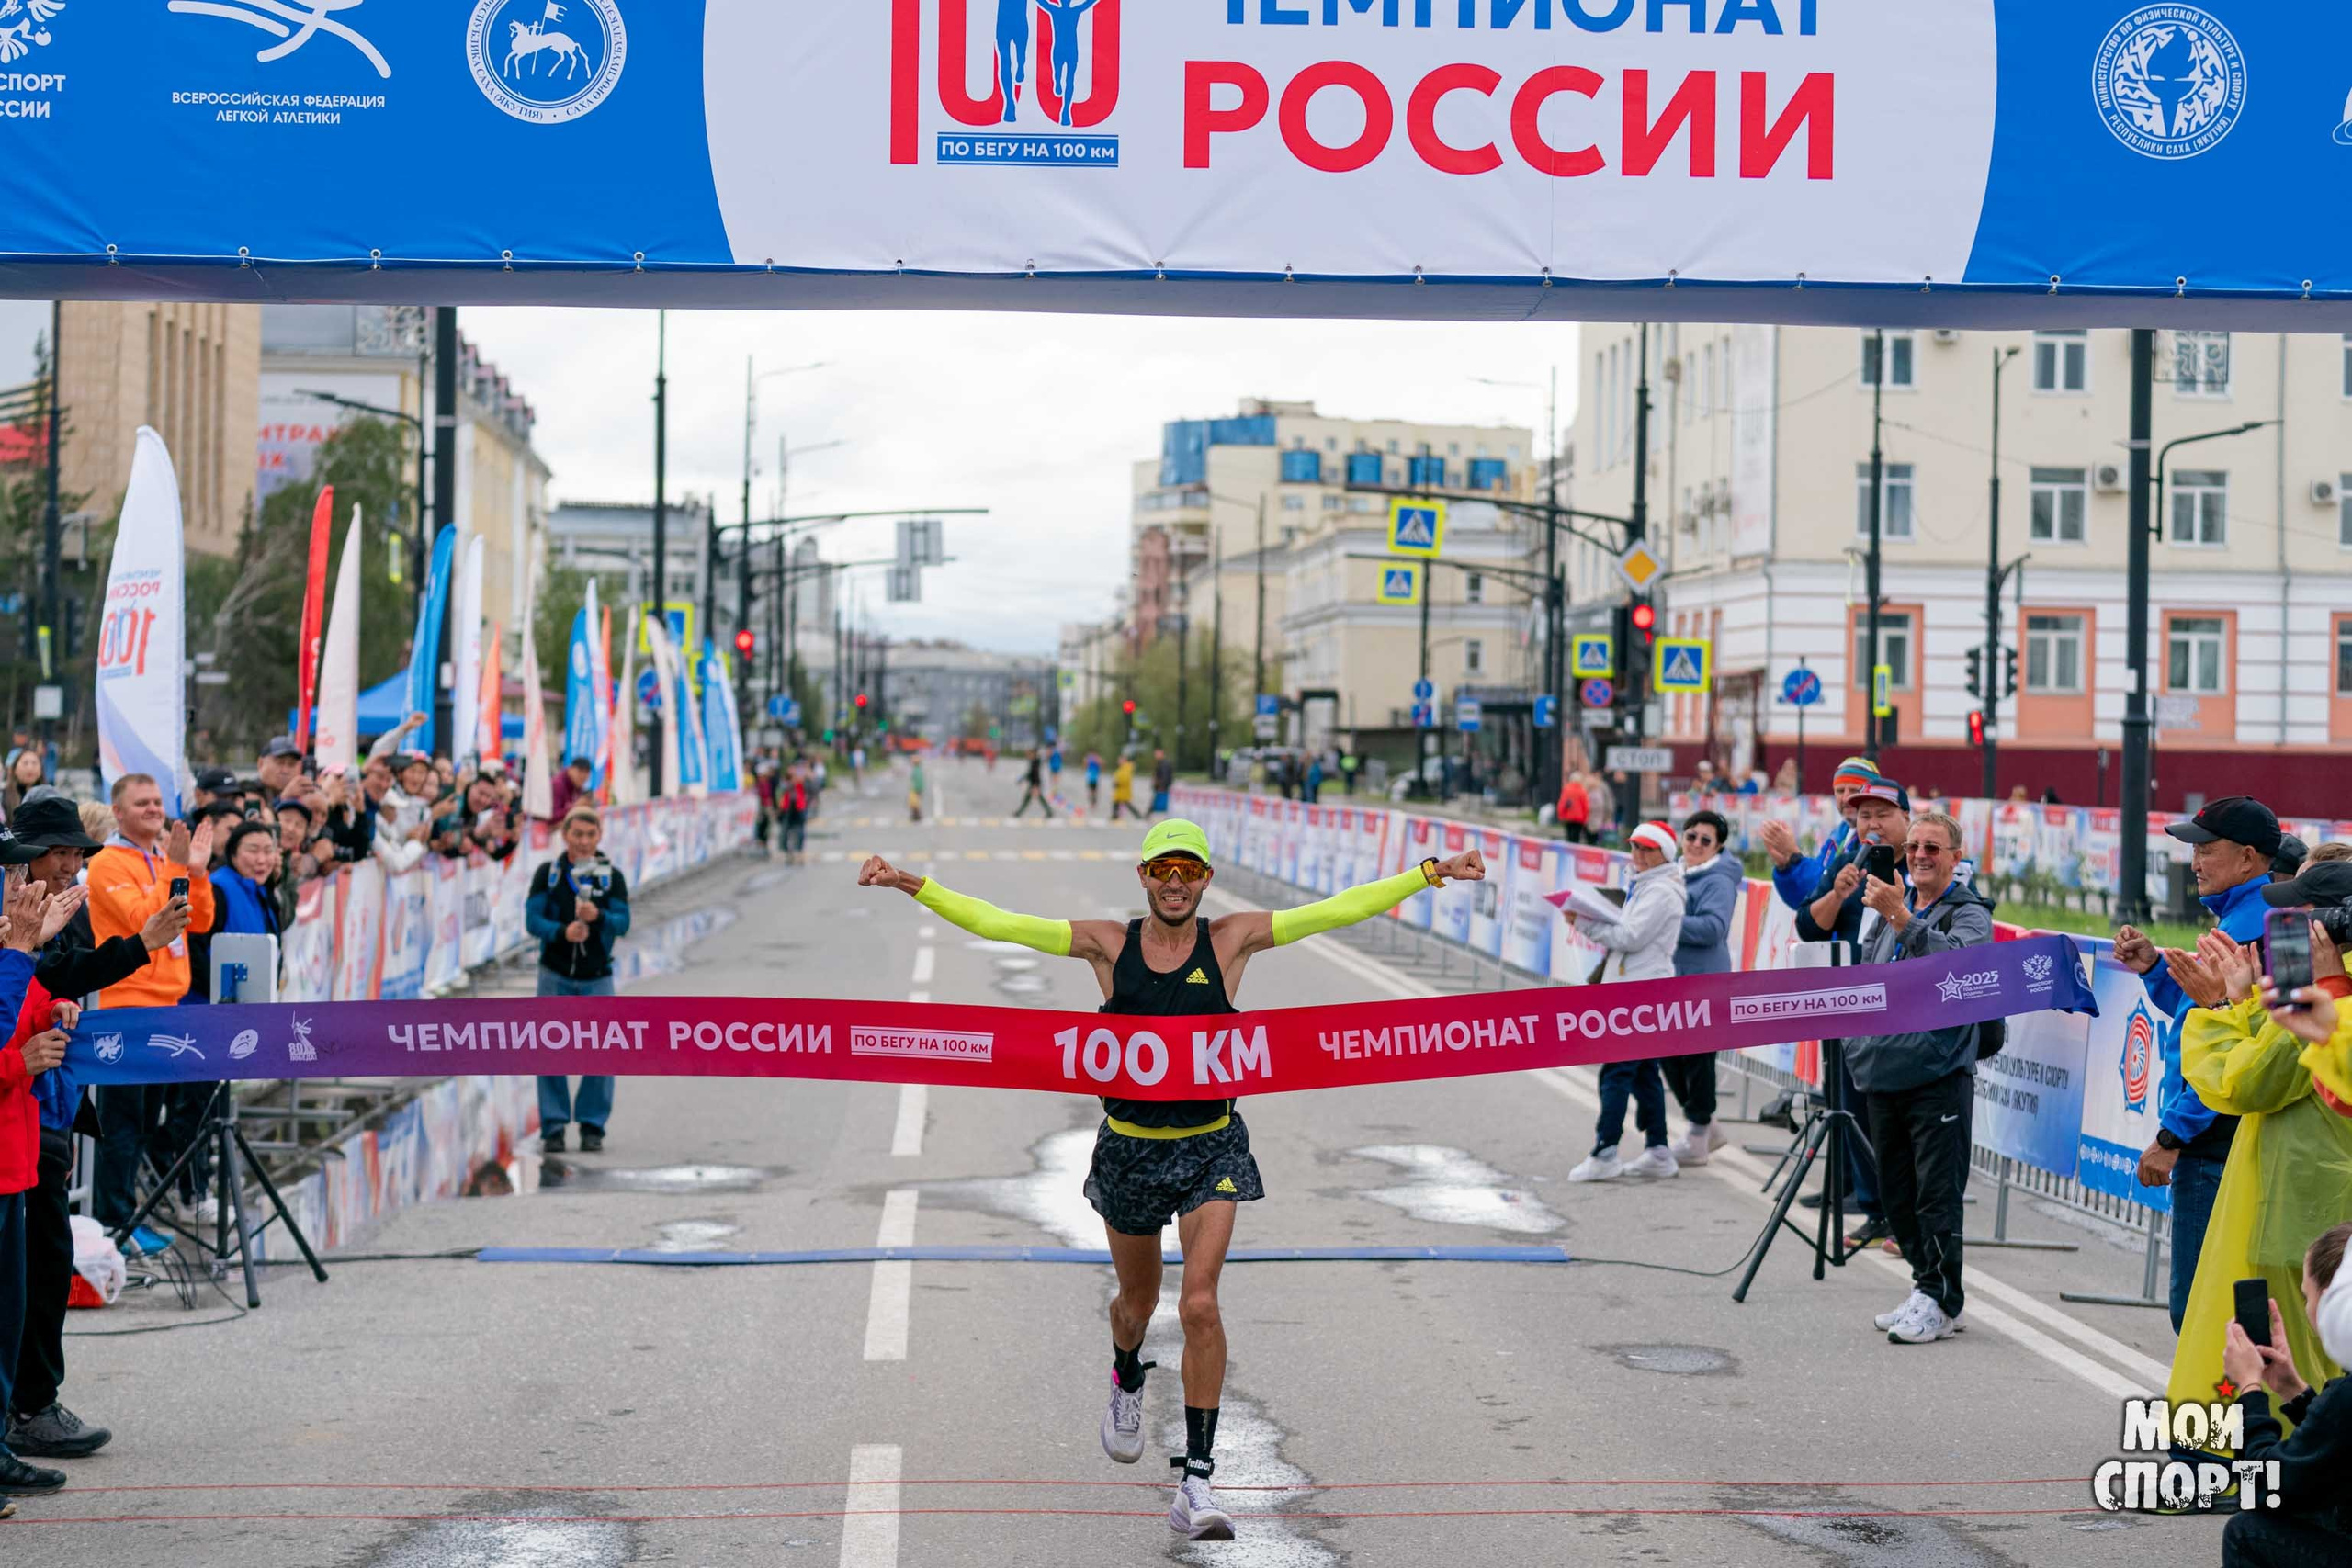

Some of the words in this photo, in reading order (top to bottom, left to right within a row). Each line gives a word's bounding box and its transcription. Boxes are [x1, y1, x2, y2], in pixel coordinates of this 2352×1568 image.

[2098, 34, 2121, 109] МИНИСТЕРСТВО
[2120, 22, 2133, 36] ПО
[2134, 7, 2199, 26] ФИЗИЧЕСКОЙ
[2199, 17, 2237, 60] КУЛЬТУРЕ
[2228, 72, 2242, 111] СПОРТУ
[172, 91, 300, 107] ВСЕРОССИЙСКАЯ
[303, 94, 386, 109] ФЕДЕРАЦИЯ
[477, 68, 496, 96] САХА
[493, 93, 543, 120] (ЯКУТИЯ)
[216, 108, 269, 123] ЛЕГКОЙ
[273, 111, 341, 124] АТЛЕТИКИ
[566, 98, 594, 116] САХА
[1183, 61, 1835, 180] РОССИИ
[2109, 113, 2163, 154] РЕСПУБЛИКИ
[2166, 143, 2191, 155] САХА
[2193, 116, 2232, 151] (ЯКУТИЯ)
[941, 141, 969, 156] ПО
[974, 141, 1019, 157] БЕГУ
[1023, 142, 1049, 157] НА
[1053, 143, 1086, 158] 100
[1091, 146, 1114, 159] км
[1617, 752, 1662, 766] СТОП
[1186, 976, 1209, 985] adidas
[1962, 970, 1999, 987] 2025
[1735, 1004, 1758, 1015] ПО
[1762, 999, 1800, 1014] БЕГУ
[1804, 998, 1826, 1010] НА
[1830, 994, 1859, 1007] 100
[1862, 993, 1883, 1004] км
[388, 1021, 649, 1052] ЧЕМПИОНАТ
[669, 1021, 831, 1054] РОССИИ
[1318, 1015, 1539, 1061] ЧЕМПИОНАТ
[1557, 999, 1712, 1042] РОССИИ
[854, 1033, 876, 1048] ПО
[880, 1035, 917, 1052] БЕГУ
[919, 1037, 939, 1052] НА
[941, 1038, 967, 1054] 100
[970, 1042, 989, 1055] км
[1054, 1026, 1170, 1086] 100
[1193, 1025, 1272, 1086] КМ
[2044, 1065, 2069, 1089] СПОРТУ
